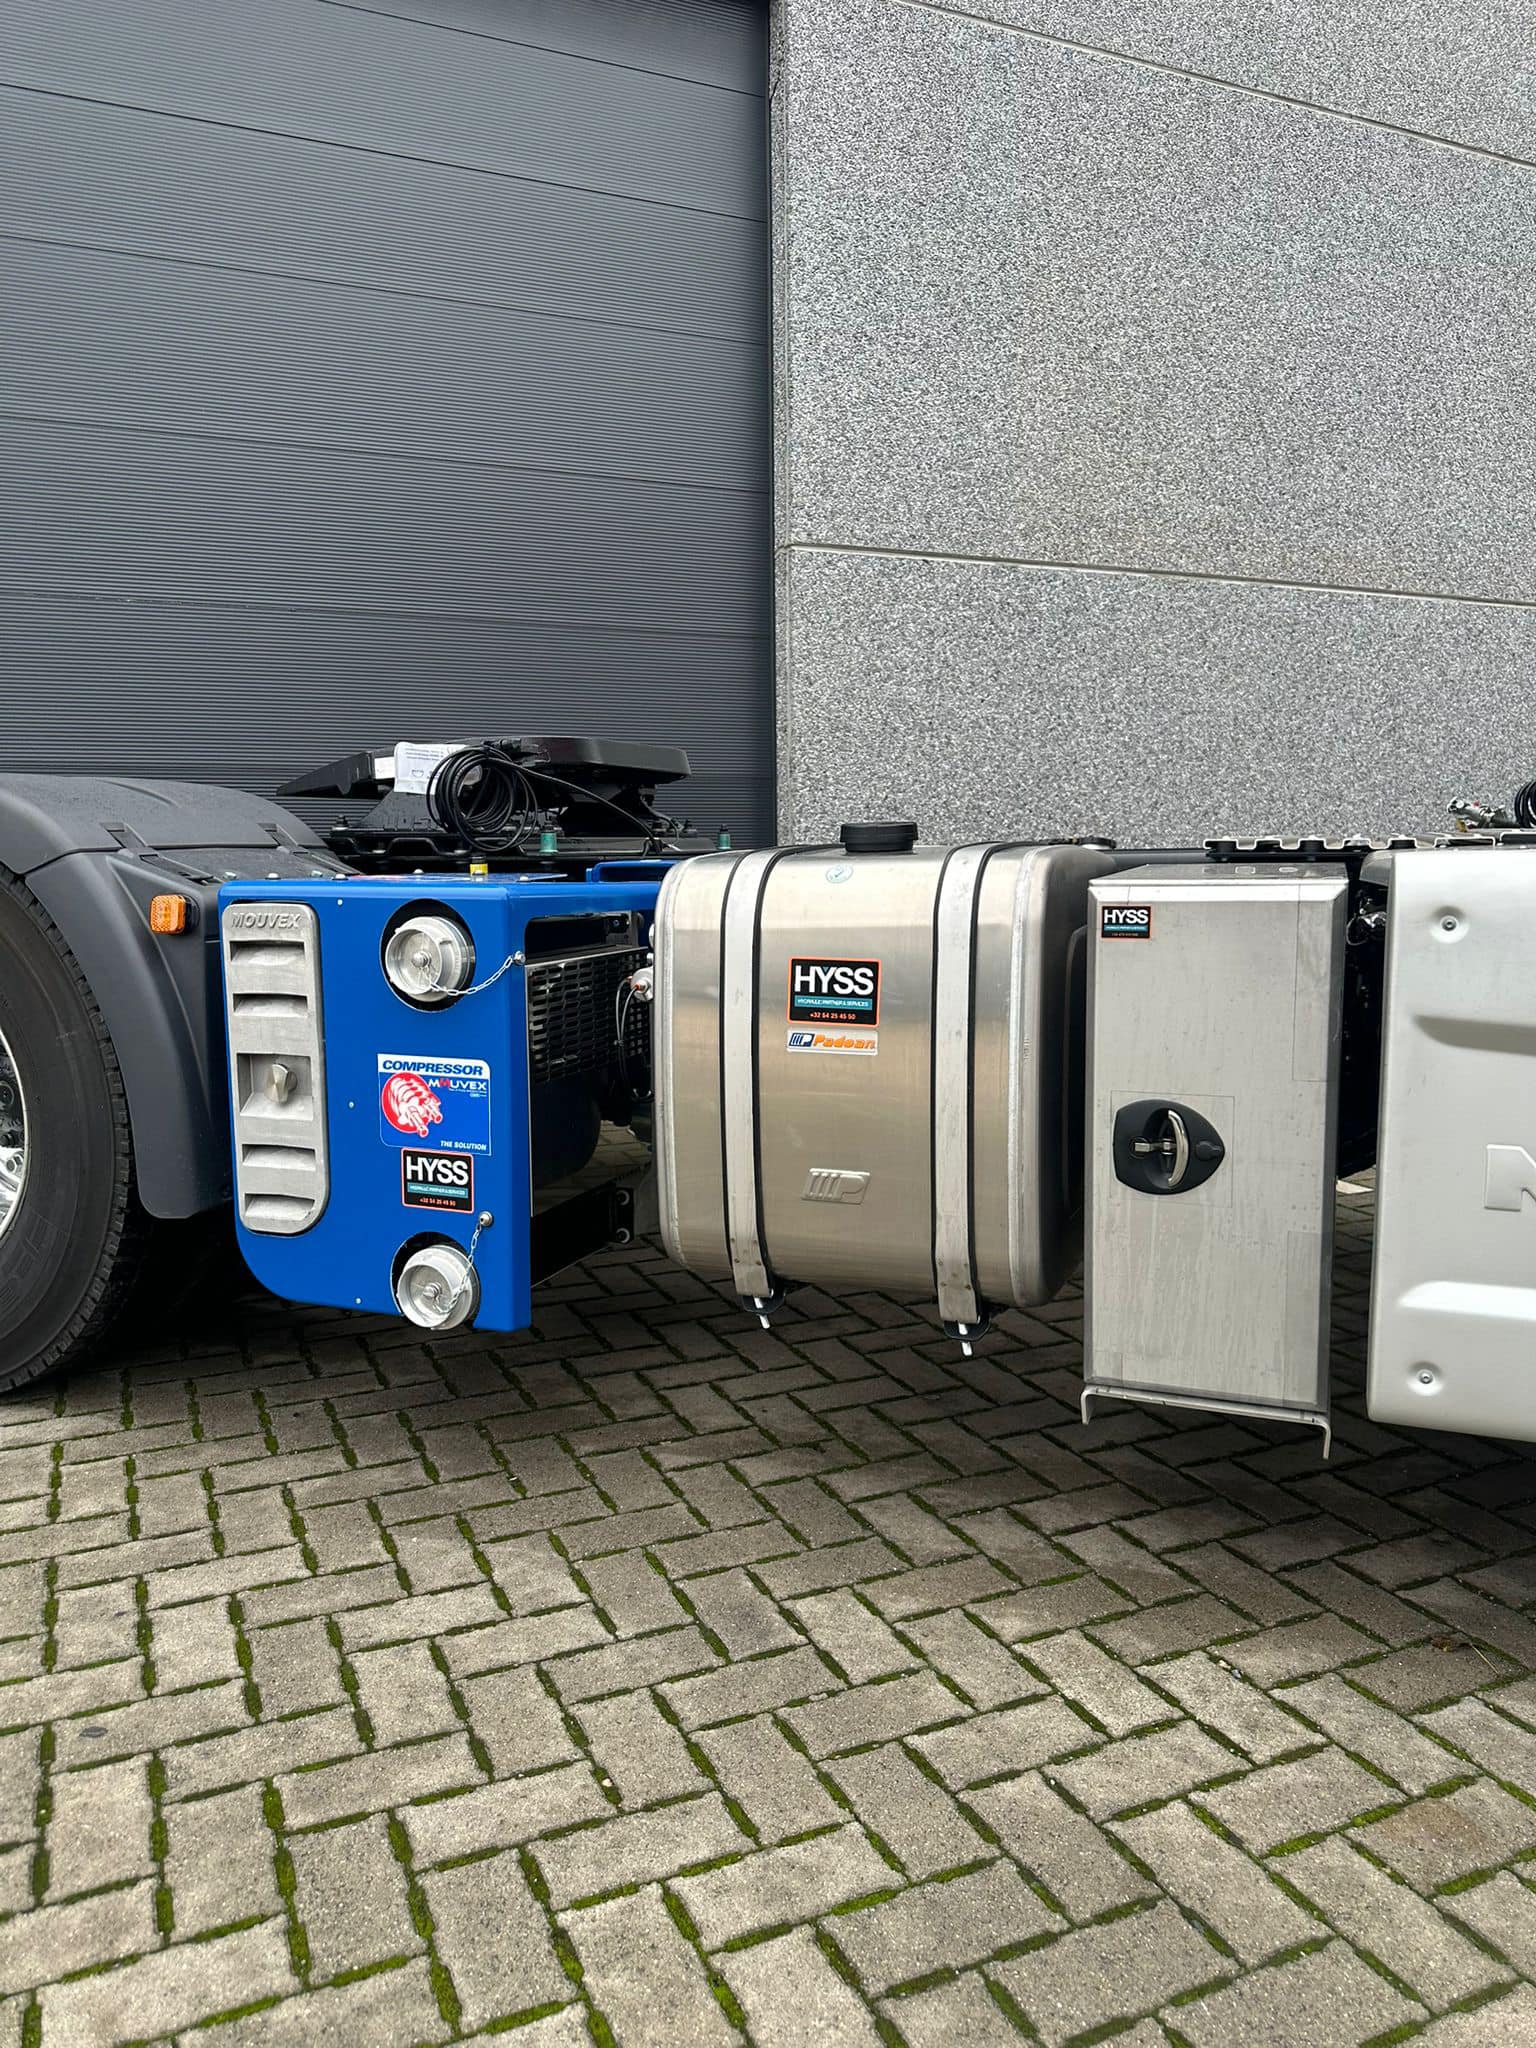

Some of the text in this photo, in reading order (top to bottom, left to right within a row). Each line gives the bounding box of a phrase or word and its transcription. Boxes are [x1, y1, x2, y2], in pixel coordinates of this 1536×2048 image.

[231, 912, 303, 929] MOUVEX
[1103, 909, 1149, 924] HYSS
[794, 965, 874, 996] HYSS
[813, 1034, 876, 1049] Padoan
[382, 1060, 484, 1076] COMPRESSOR
[440, 1140, 487, 1151] THE SOLUTION
[406, 1155, 469, 1186] HYSS
